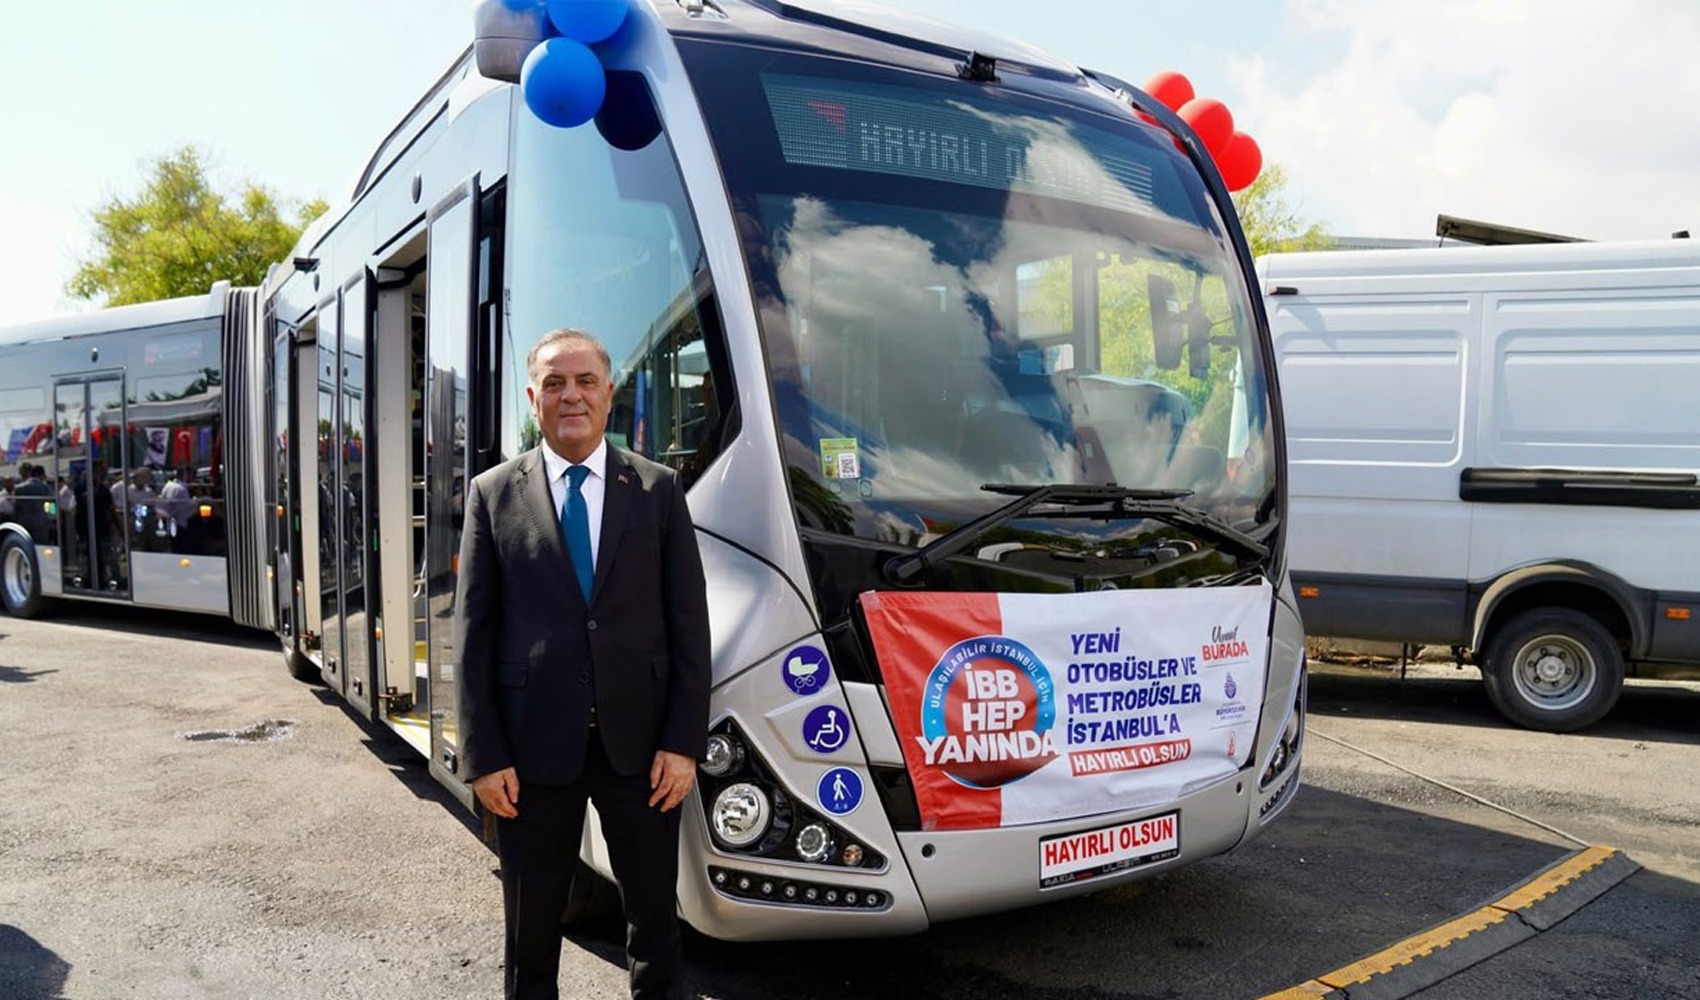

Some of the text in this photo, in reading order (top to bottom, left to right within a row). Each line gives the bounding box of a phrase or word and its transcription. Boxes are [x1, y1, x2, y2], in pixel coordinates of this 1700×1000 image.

[861, 122, 987, 177] HAYIRLI
[1071, 626, 1120, 655] YENİ
[1202, 641, 1248, 660] BURADA
[990, 642, 1039, 677] İSTANBUL
[1067, 656, 1197, 684] OTOBÜSLER VE
[964, 662, 1019, 699] İBB
[1067, 681, 1202, 714] METROBÜSLER
[962, 700, 1026, 732] HEP
[915, 729, 1062, 766] YANINDA
[1072, 742, 1190, 773] HAYIRLI OLSUN
[1045, 817, 1173, 866] HAYIRLI OLSUN
